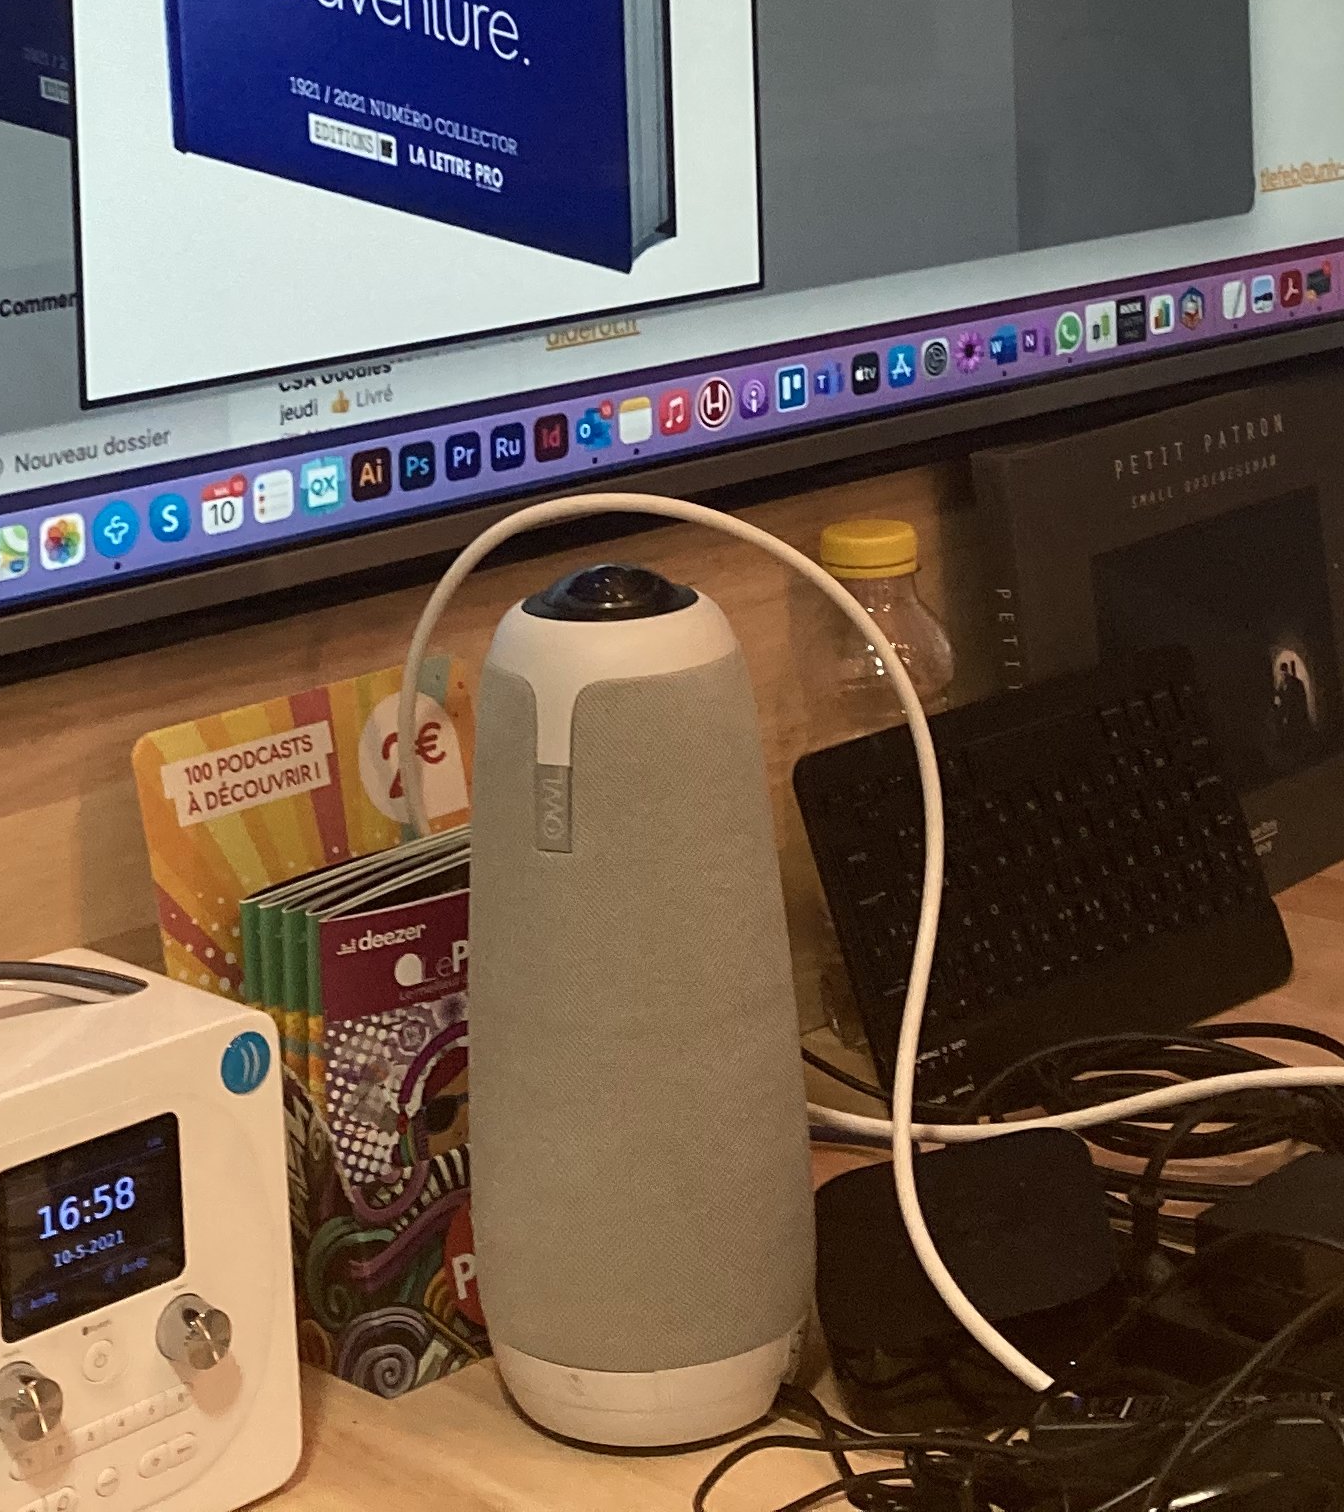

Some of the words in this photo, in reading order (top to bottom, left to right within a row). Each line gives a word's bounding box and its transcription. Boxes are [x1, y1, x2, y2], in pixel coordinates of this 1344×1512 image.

[435, 118, 518, 156] COLLECTOR
[409, 144, 427, 168] LA
[429, 149, 472, 180] LETTRE
[475, 163, 504, 188] PRO
[280, 399, 318, 425] jeudi
[14, 445, 97, 473] Nouveau
[104, 428, 171, 457] dossier
[453, 445, 474, 467] Pr
[495, 437, 520, 459] Ru
[1114, 442, 1183, 481] PETIT
[1204, 413, 1284, 453] PATRON
[360, 458, 383, 487] Ai
[407, 455, 430, 478] Ps
[161, 508, 178, 532] S
[209, 500, 236, 526] 10
[185, 764, 212, 786] 100
[217, 734, 313, 777] PODCASTS
[188, 792, 202, 816] À
[206, 765, 310, 810] DÉCOUVRIR
[358, 922, 427, 951] deezer
[37, 1176, 136, 1240] 16:58
[52, 1228, 126, 1268] 10-5-2021
